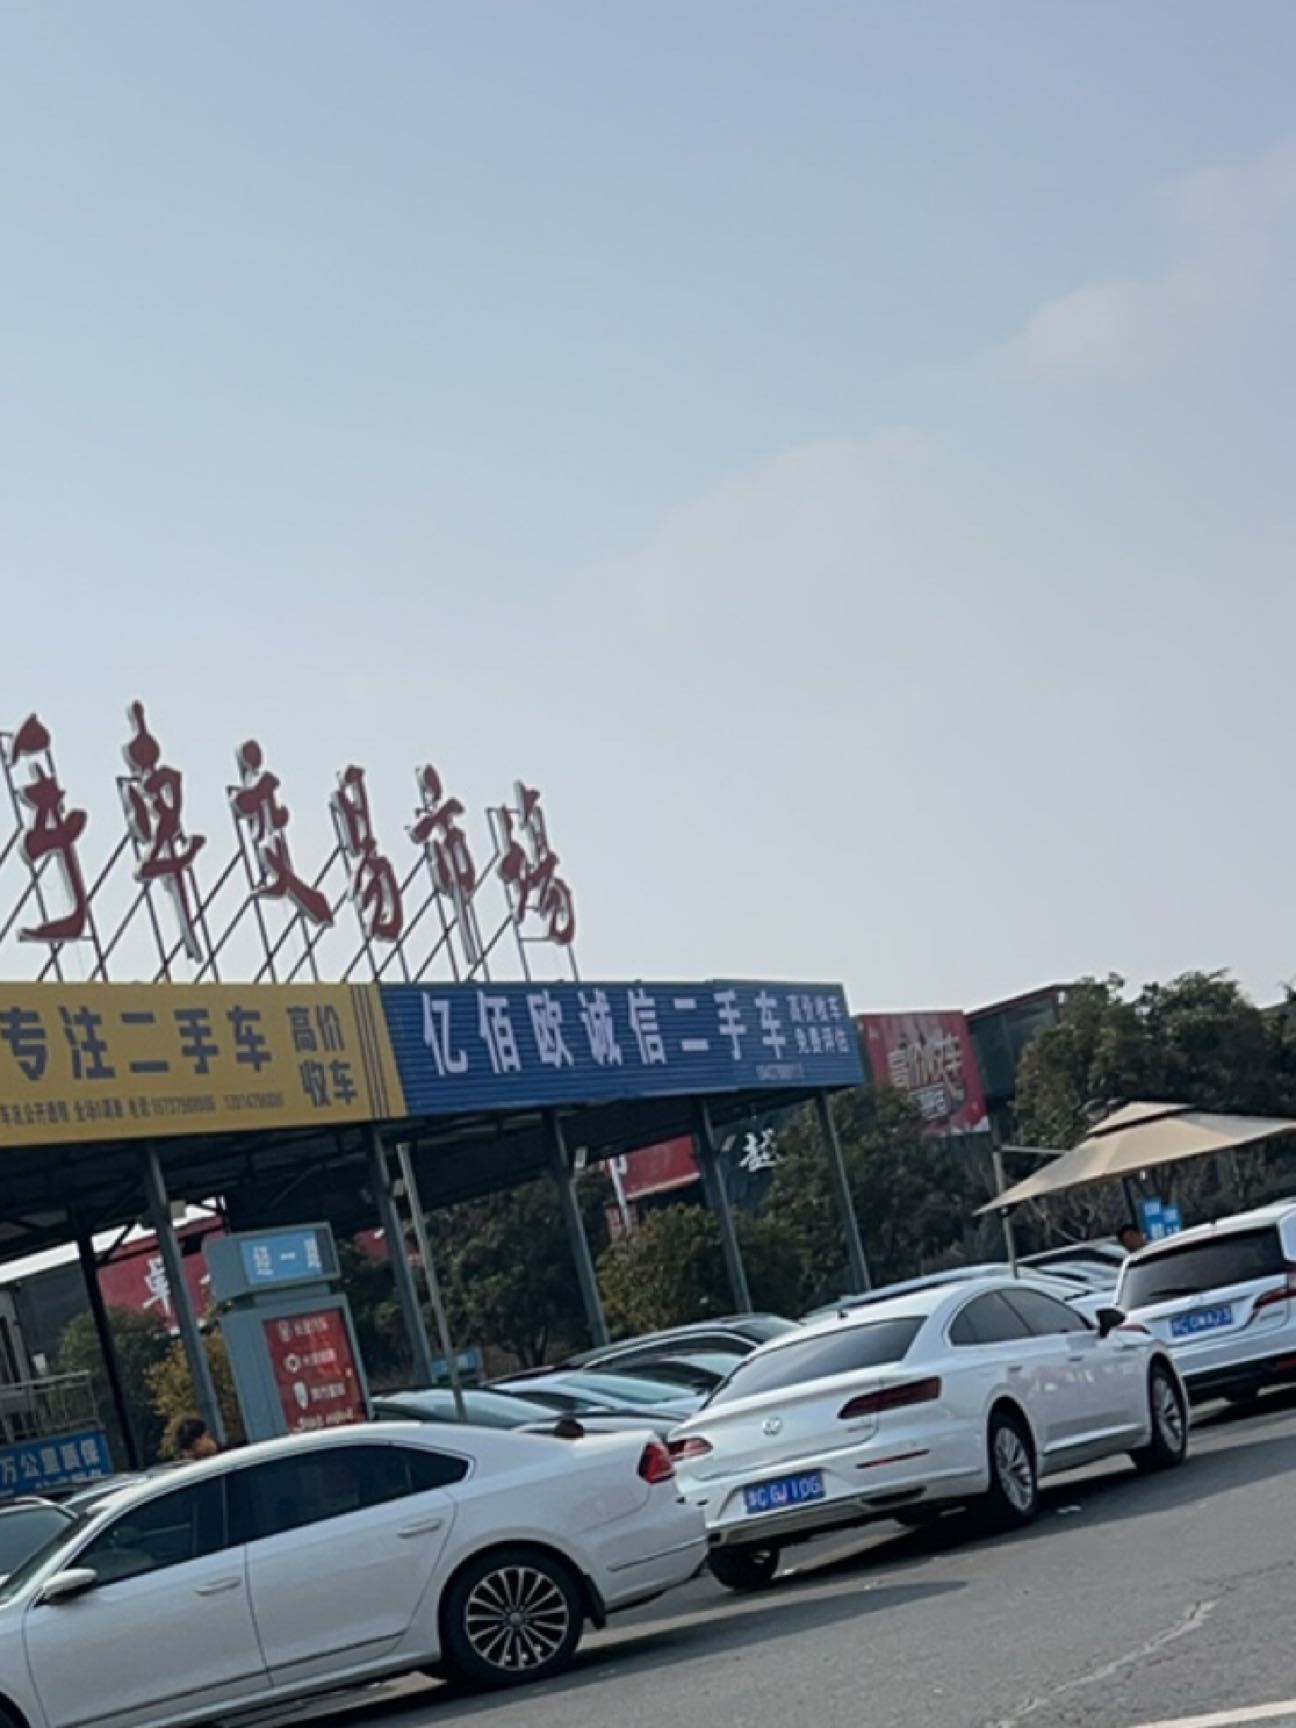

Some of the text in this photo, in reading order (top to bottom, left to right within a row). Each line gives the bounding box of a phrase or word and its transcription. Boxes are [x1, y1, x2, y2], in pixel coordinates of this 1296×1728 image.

[286, 1005, 345, 1052] 高价
[422, 988, 786, 1075] 亿佰欧诚信二手车
[298, 1059, 358, 1108] 收车
